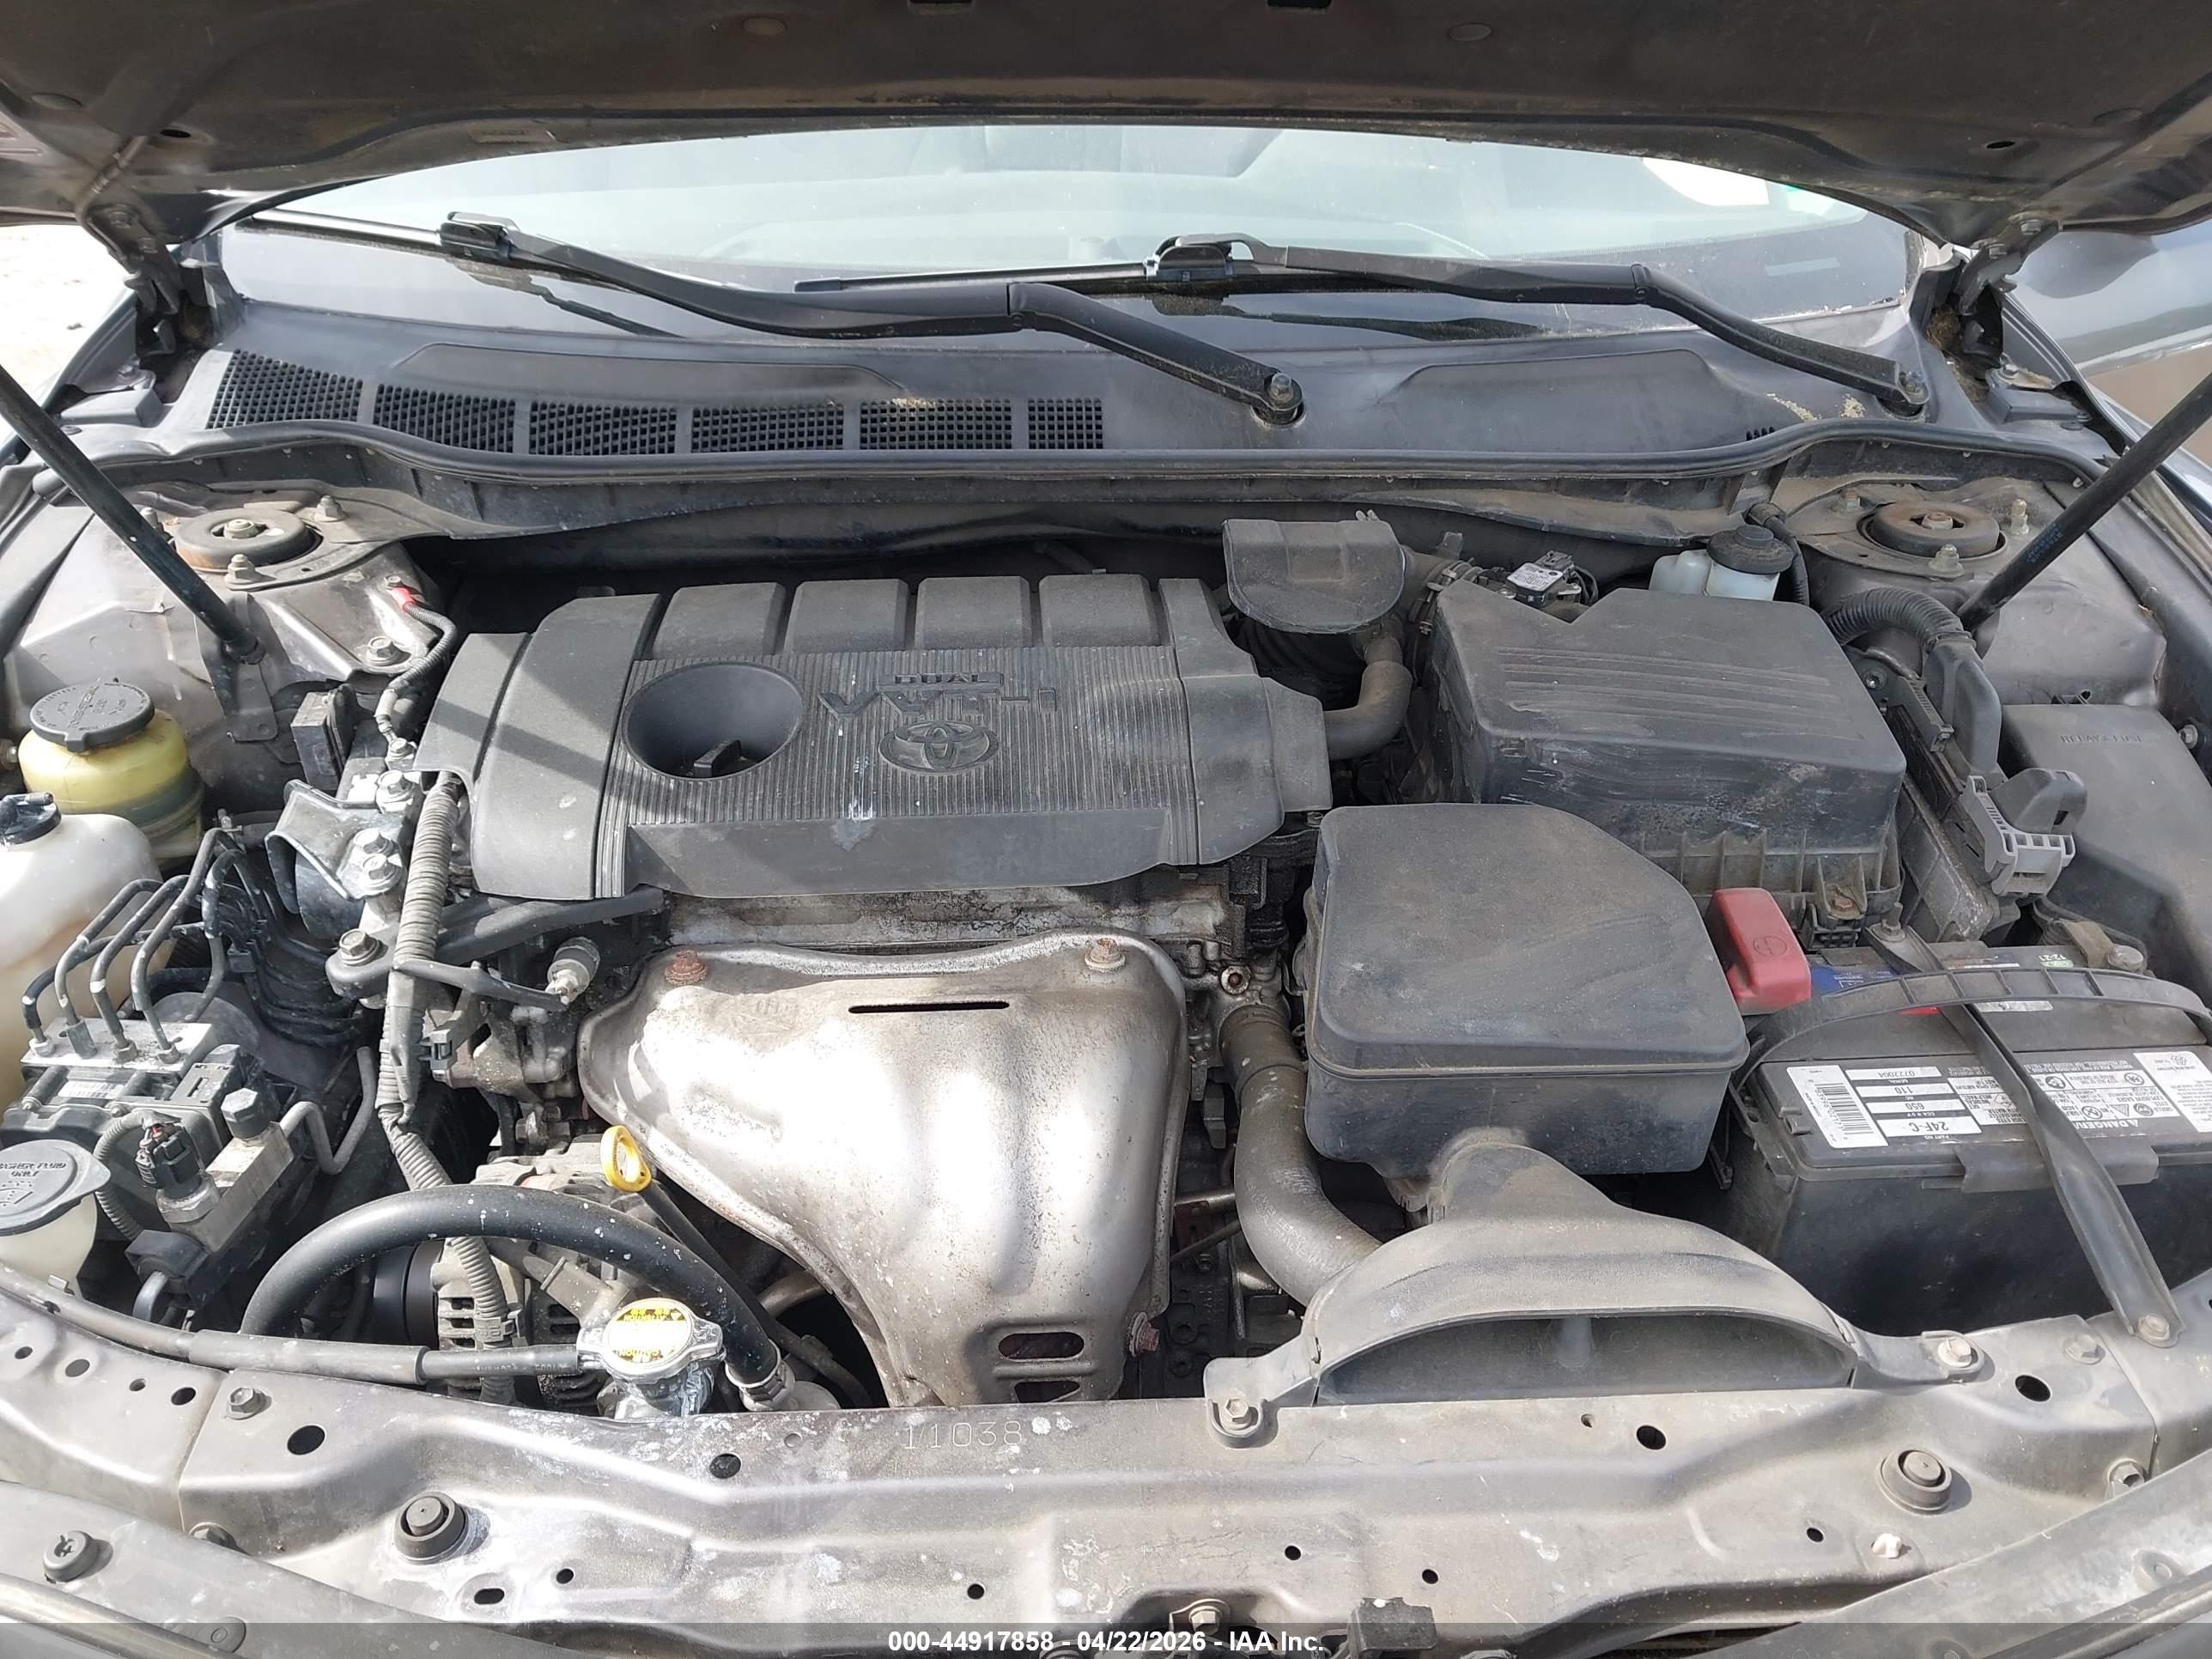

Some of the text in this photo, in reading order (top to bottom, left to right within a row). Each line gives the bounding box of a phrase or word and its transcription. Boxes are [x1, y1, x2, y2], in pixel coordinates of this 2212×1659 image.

[894, 672, 993, 684] DUAL
[1878, 1070, 1916, 1079] 0722004
[1893, 1086, 1913, 1095] 110
[1905, 1103, 1925, 1111] 650
[1908, 1121, 1949, 1133] 24F-C
